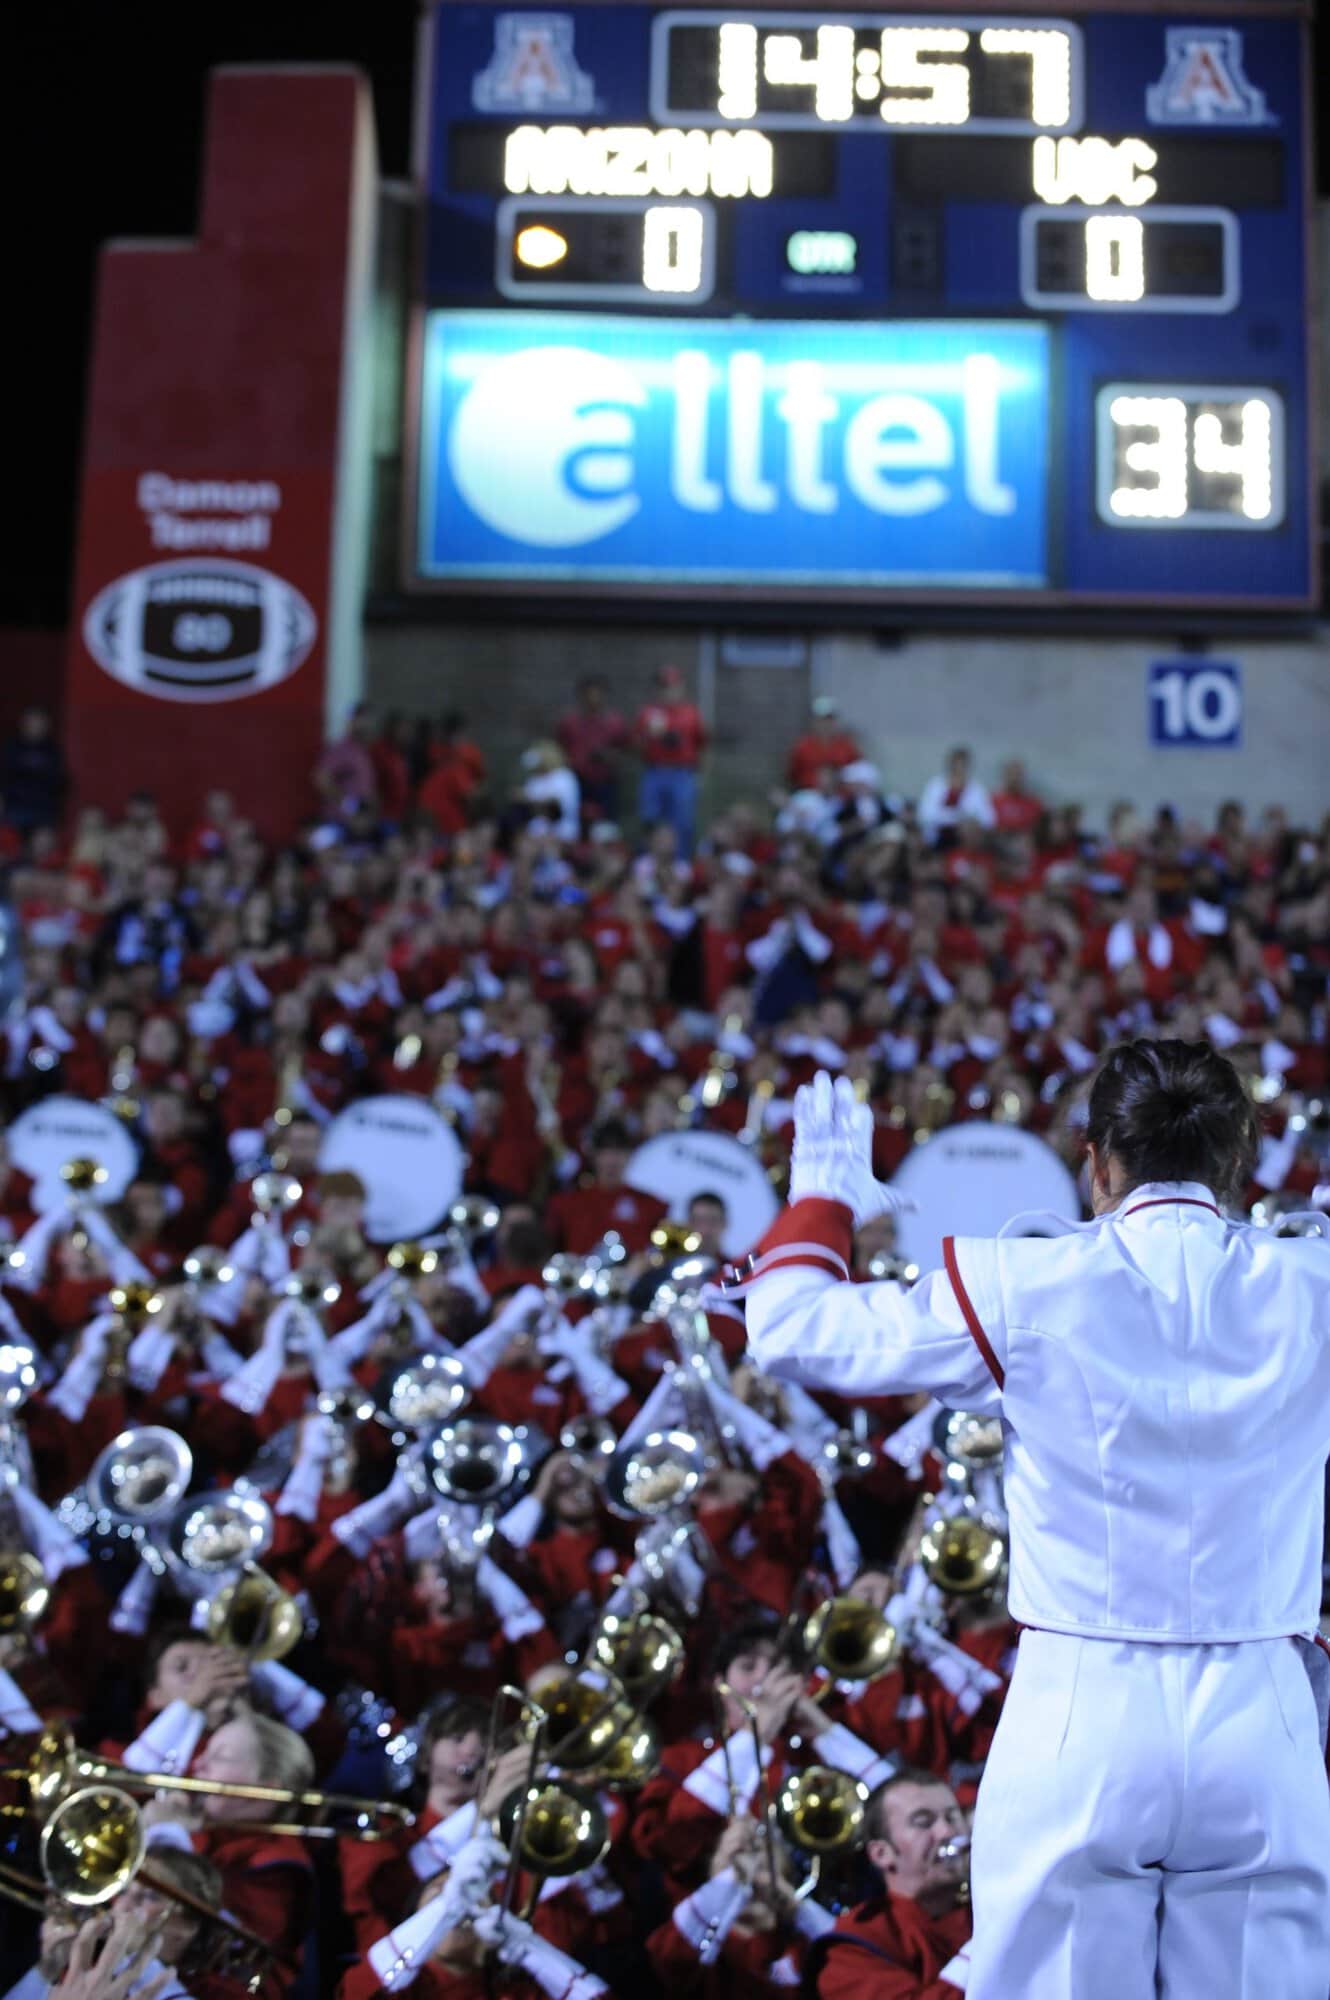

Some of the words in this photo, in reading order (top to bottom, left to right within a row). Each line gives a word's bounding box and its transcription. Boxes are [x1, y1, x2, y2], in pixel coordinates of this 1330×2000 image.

[718, 22, 1070, 127] 14:57
[1146, 26, 1272, 126] A
[643, 206, 704, 293] 0
[1085, 215, 1145, 301] 0
[552, 348, 1017, 518] alltel
[1110, 396, 1271, 519] 34
[1151, 671, 1240, 738] 10
